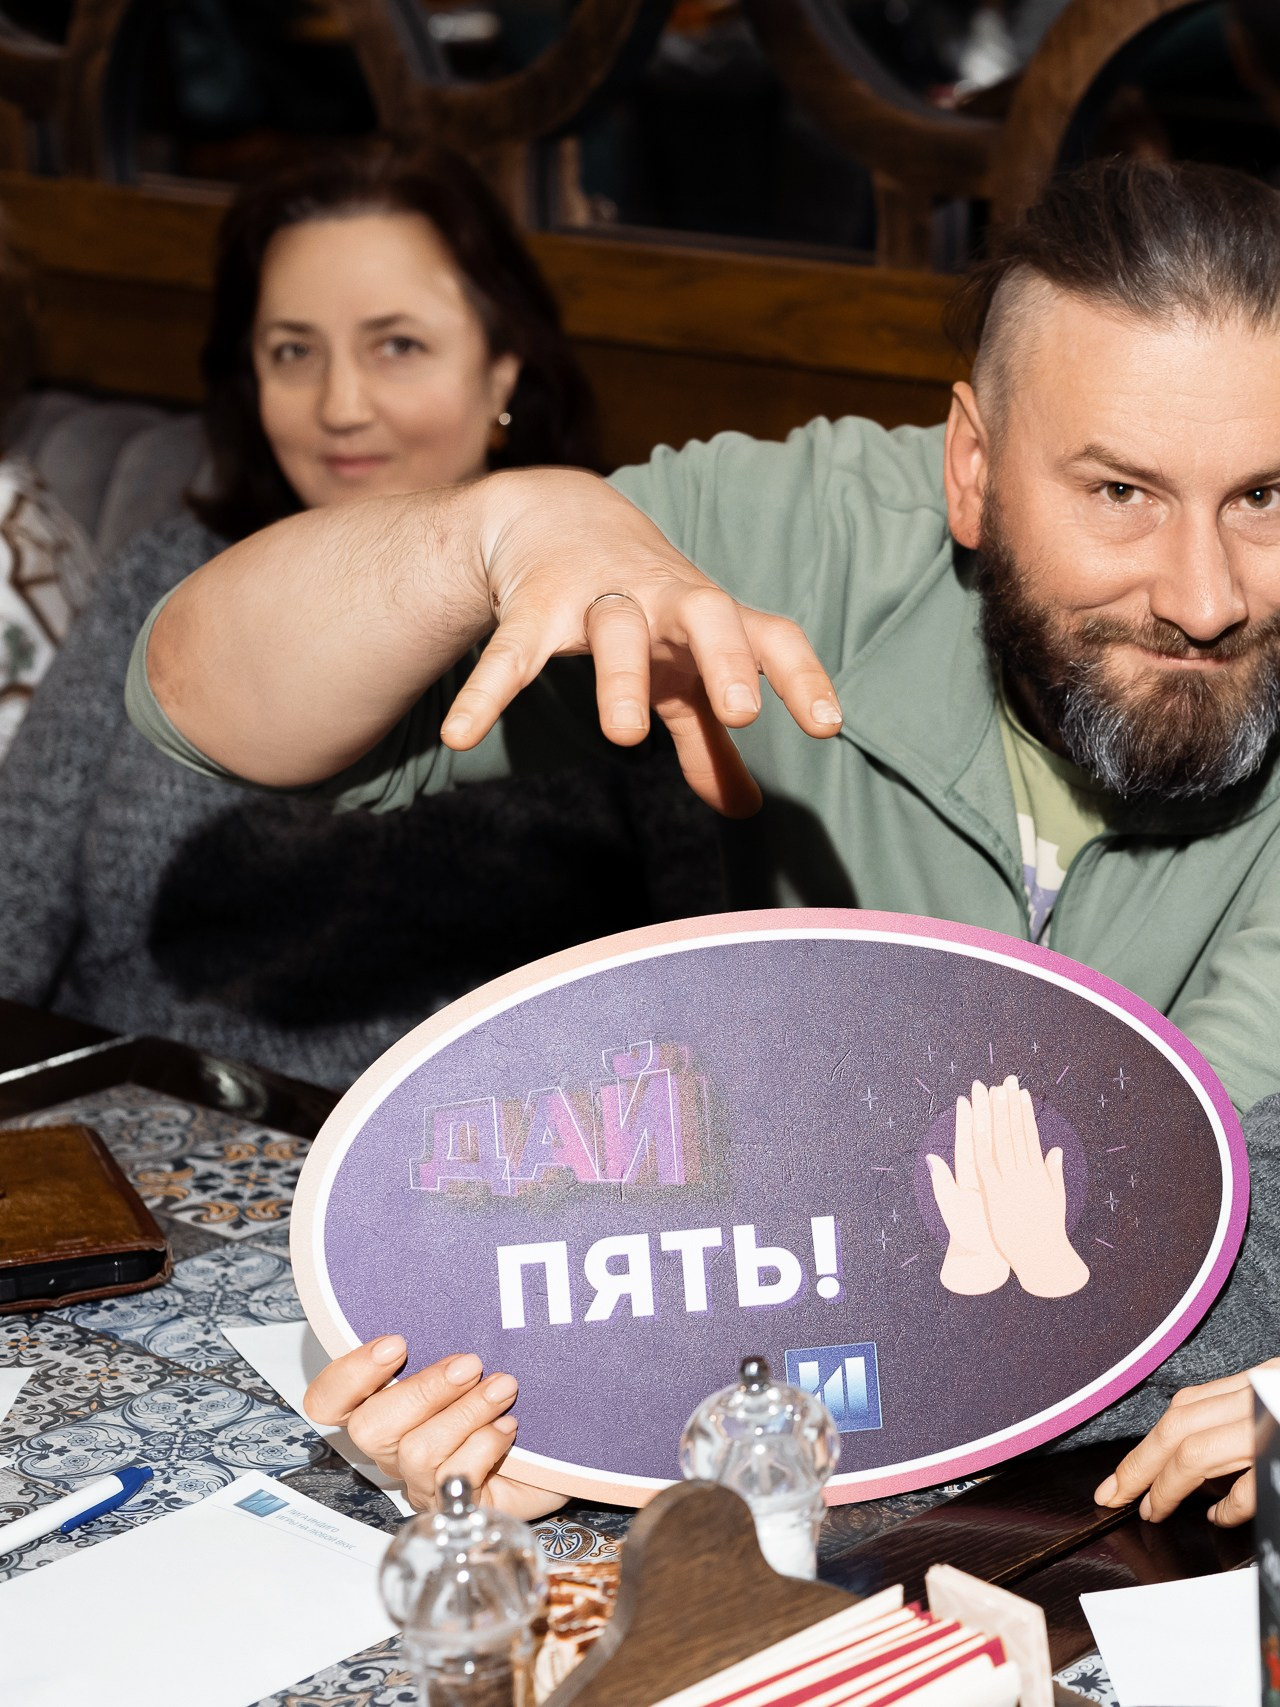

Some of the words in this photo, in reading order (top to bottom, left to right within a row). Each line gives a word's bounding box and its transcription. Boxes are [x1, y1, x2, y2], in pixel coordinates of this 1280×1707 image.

[409, 1040, 688, 1196] ДАЙ
[497, 1215, 841, 1330] ПЯТЬ!
[275, 1515, 298, 1526] ИГРЫ
[297, 1523, 309, 1531] НА
[309, 1528, 338, 1543] ЛЮБОЙ
[334, 1539, 357, 1551] ВКУС
[307, 1517, 340, 1533] ИНДИГО
